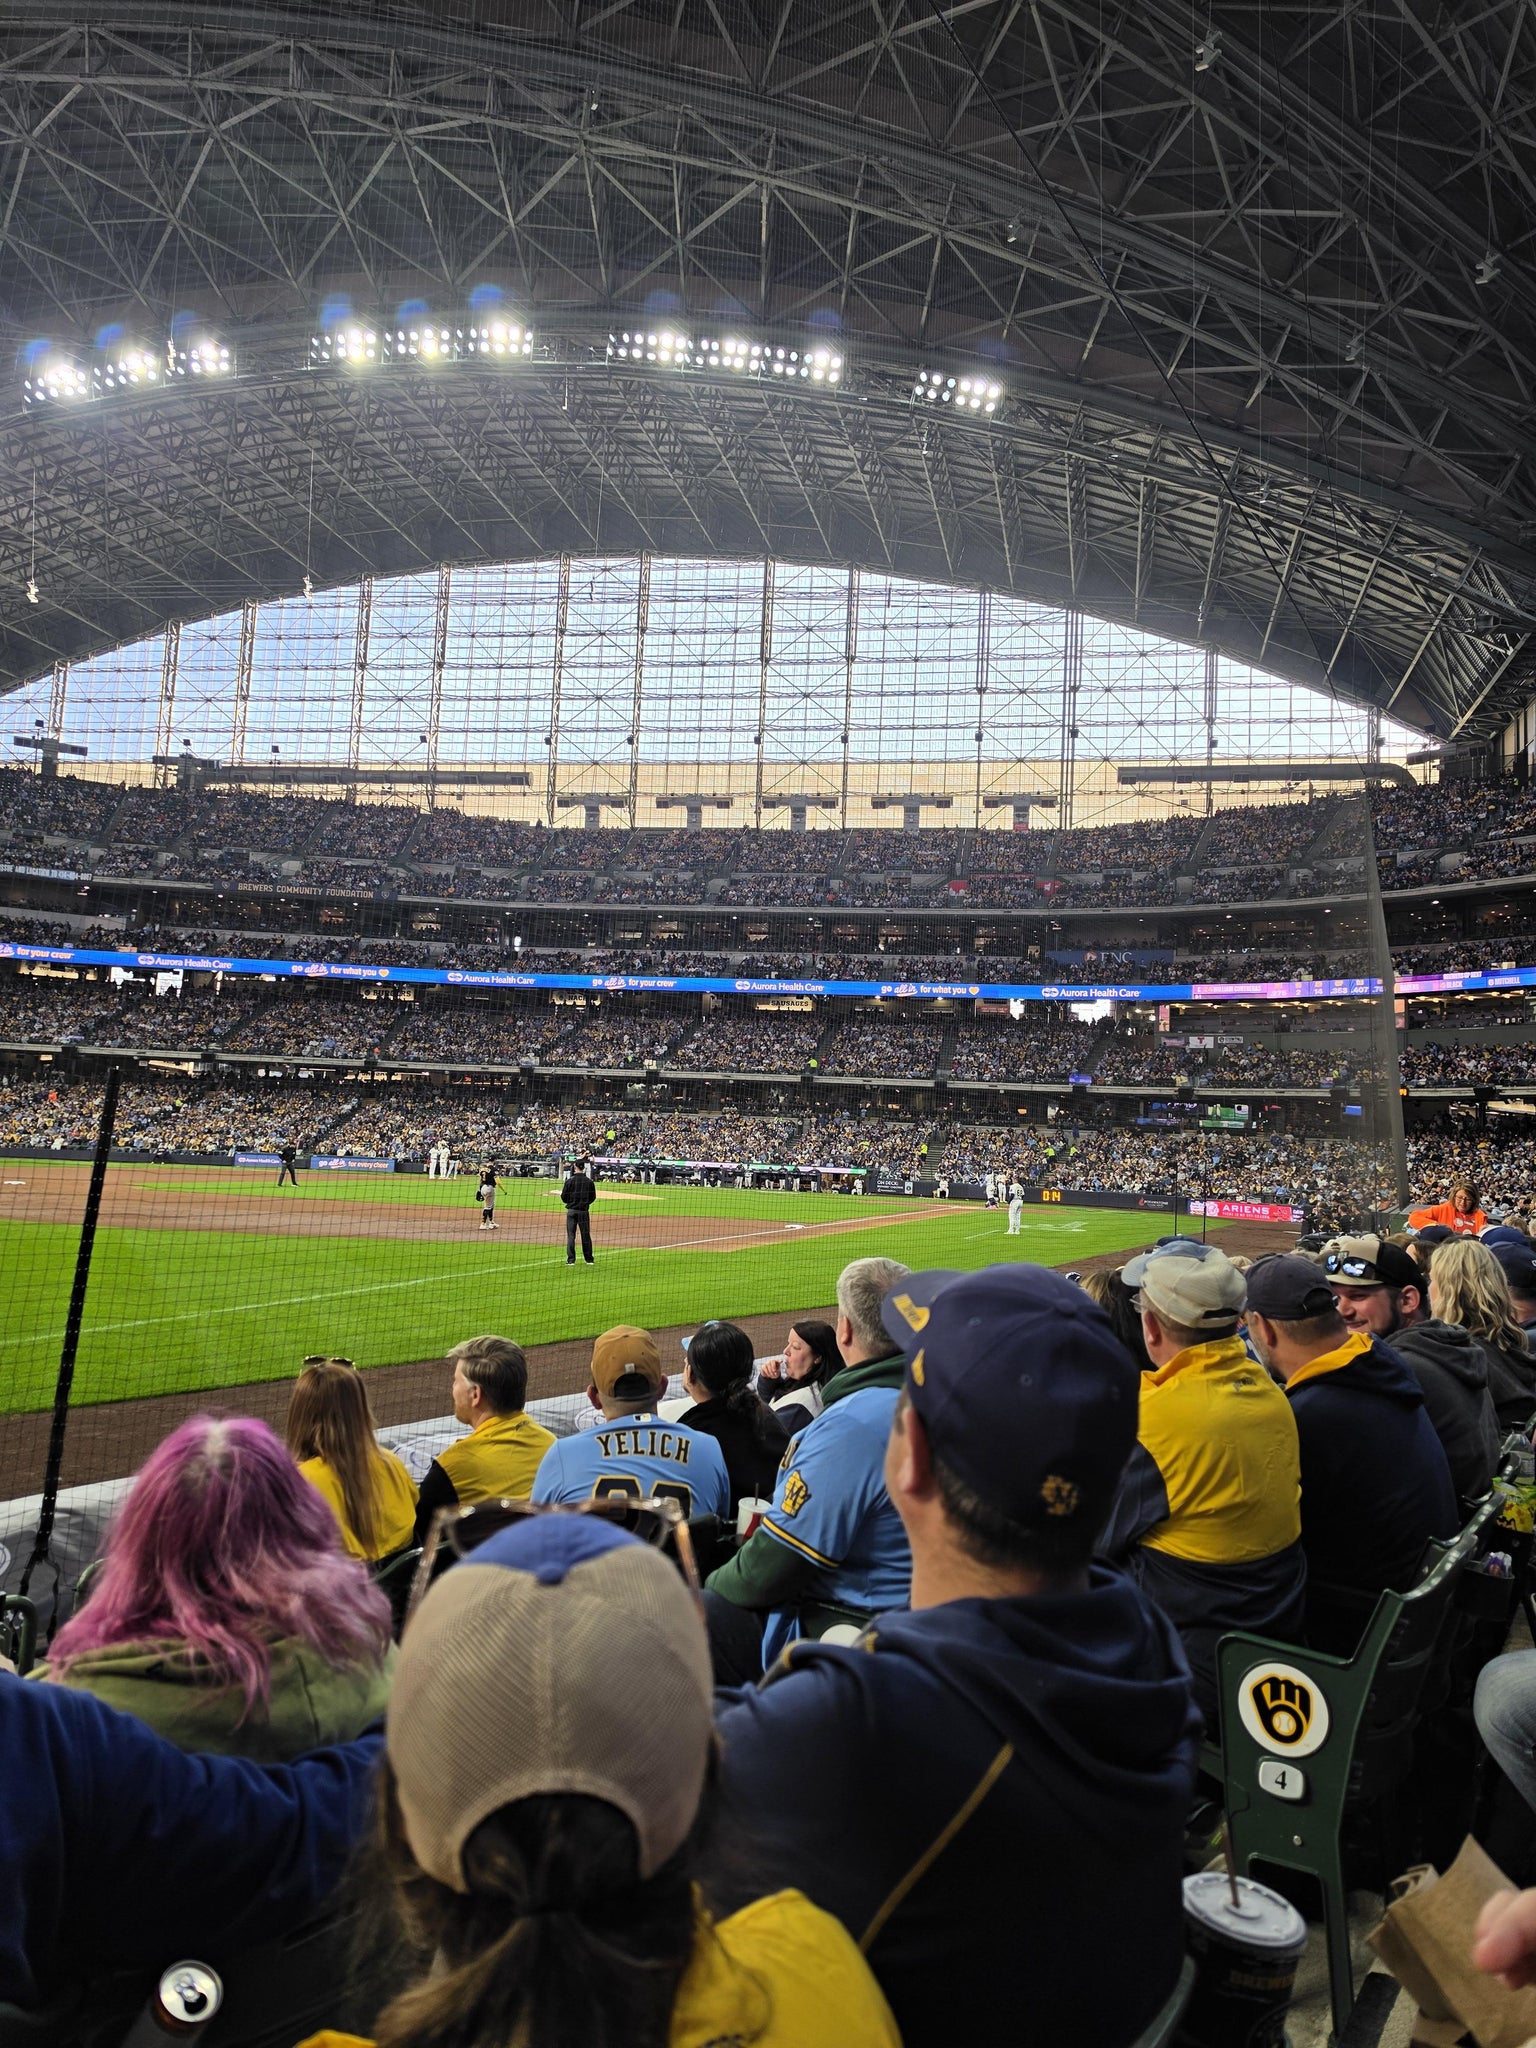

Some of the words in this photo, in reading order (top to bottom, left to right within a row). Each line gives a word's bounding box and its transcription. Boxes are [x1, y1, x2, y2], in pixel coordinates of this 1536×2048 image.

[238, 882, 273, 892] BREWERS
[276, 886, 322, 896] COMMUNITY
[326, 888, 374, 898] FOUNDATION
[17, 947, 29, 956] for
[30, 948, 50, 958] your
[155, 957, 182, 966] Aurora
[184, 959, 212, 968] Health
[212, 960, 232, 968] Care
[292, 965, 303, 973] go
[330, 966, 342, 974] for
[343, 967, 362, 976] what
[464, 974, 490, 983] Aurora
[492, 975, 516, 984] Health
[517, 976, 535, 984] Care
[592, 978, 602, 986] go
[752, 982, 777, 990] Aurora
[778, 983, 804, 991] Health
[882, 986, 892, 994] go
[920, 985, 932, 993] for
[932, 986, 951, 994] what
[952, 987, 966, 995] you
[1060, 988, 1088, 997] Aurora
[1089, 988, 1118, 997] Health
[1119, 989, 1140, 997] Care
[1222, 1204, 1270, 1215] ARIENS
[595, 1430, 691, 1466] YELICH
[1275, 1770, 1287, 1790] 4
